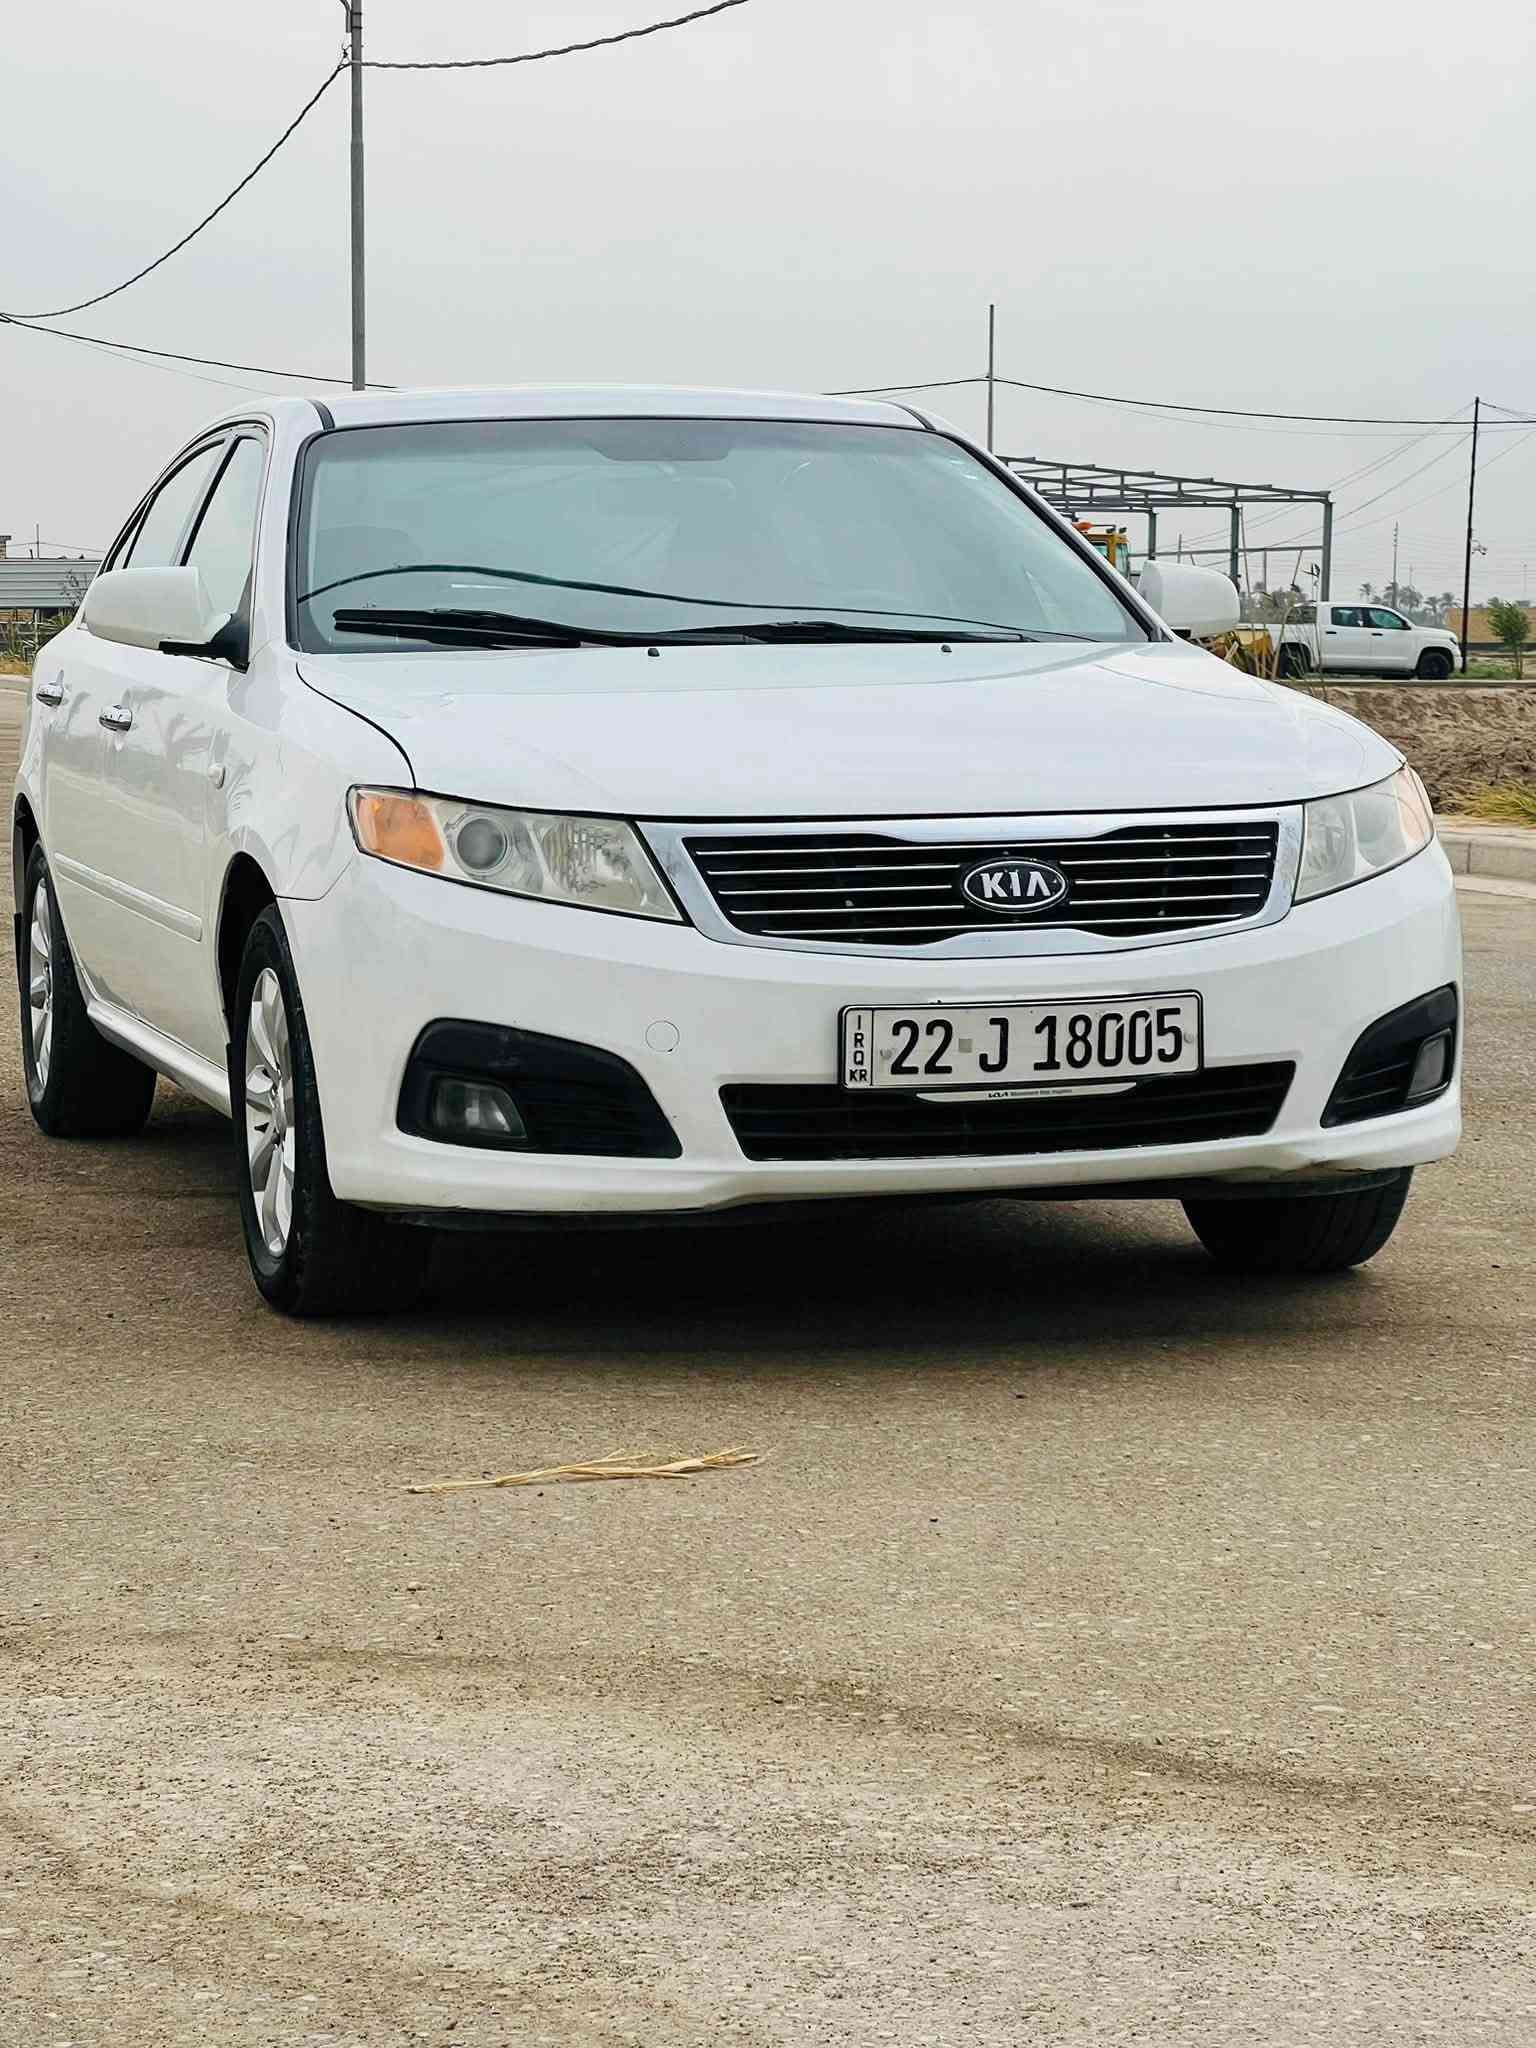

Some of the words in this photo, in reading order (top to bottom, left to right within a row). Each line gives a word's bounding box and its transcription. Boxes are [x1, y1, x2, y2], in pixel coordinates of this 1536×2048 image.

[980, 871, 1051, 898] KIA
[890, 1019, 953, 1075] 22
[979, 1017, 1009, 1073] J
[1033, 1007, 1183, 1072] 18005
[849, 1068, 867, 1082] KR
